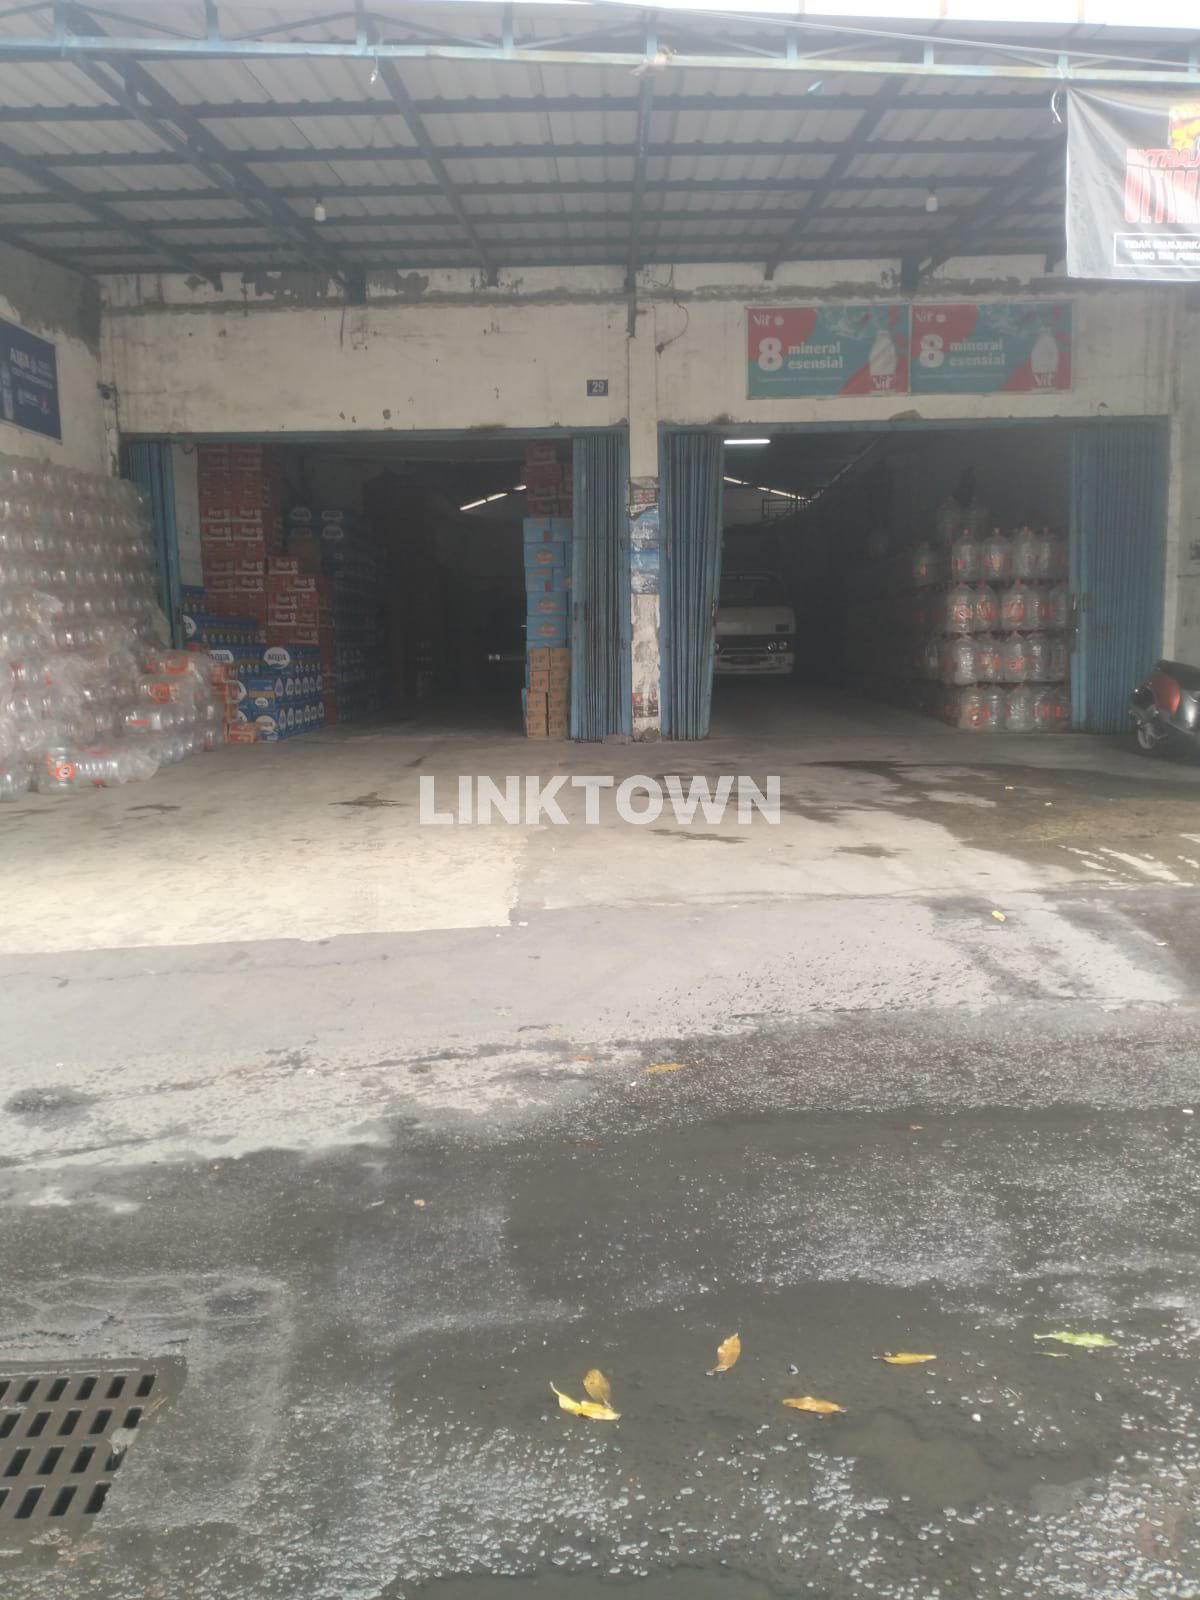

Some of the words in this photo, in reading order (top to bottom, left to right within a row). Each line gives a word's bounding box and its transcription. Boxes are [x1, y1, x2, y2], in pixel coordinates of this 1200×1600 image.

[1124, 166, 1200, 224] ULTIM
[758, 337, 783, 371] 8
[787, 340, 841, 355] mineral
[787, 355, 844, 370] esensial
[919, 334, 944, 368] 8
[949, 338, 1003, 353] mineral
[948, 352, 1006, 367] esensial
